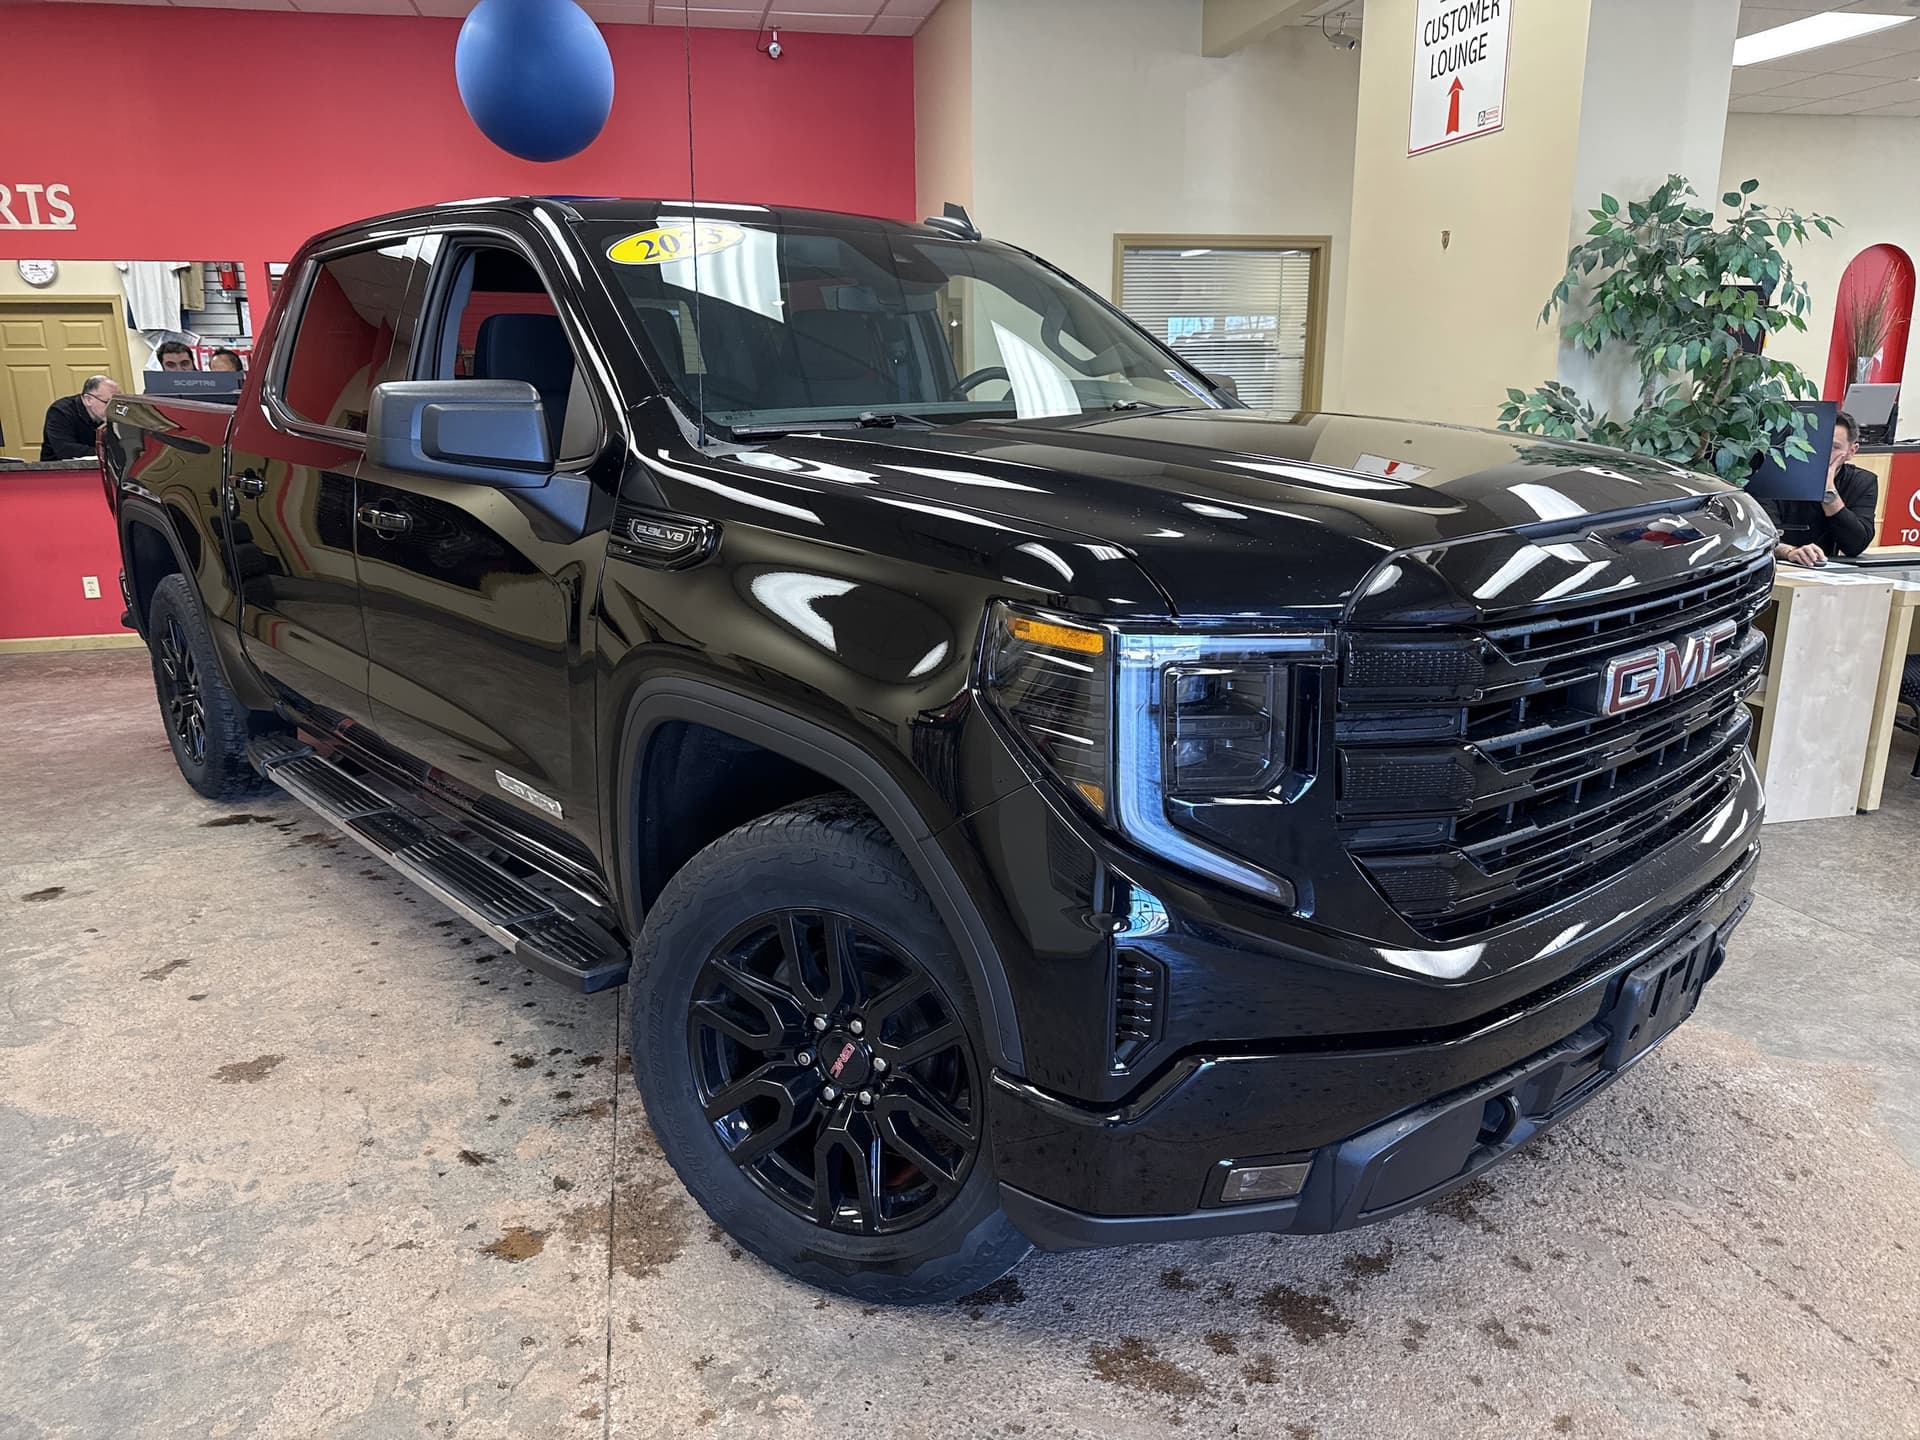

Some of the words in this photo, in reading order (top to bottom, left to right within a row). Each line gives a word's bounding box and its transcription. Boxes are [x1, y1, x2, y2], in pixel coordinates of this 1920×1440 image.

[1424, 0, 1500, 47] CUSTOMER
[1430, 32, 1488, 80] LOUNGE
[173, 379, 217, 388] SCEPTRE
[1602, 619, 1737, 716] GMC
[829, 1042, 856, 1079] GMC
